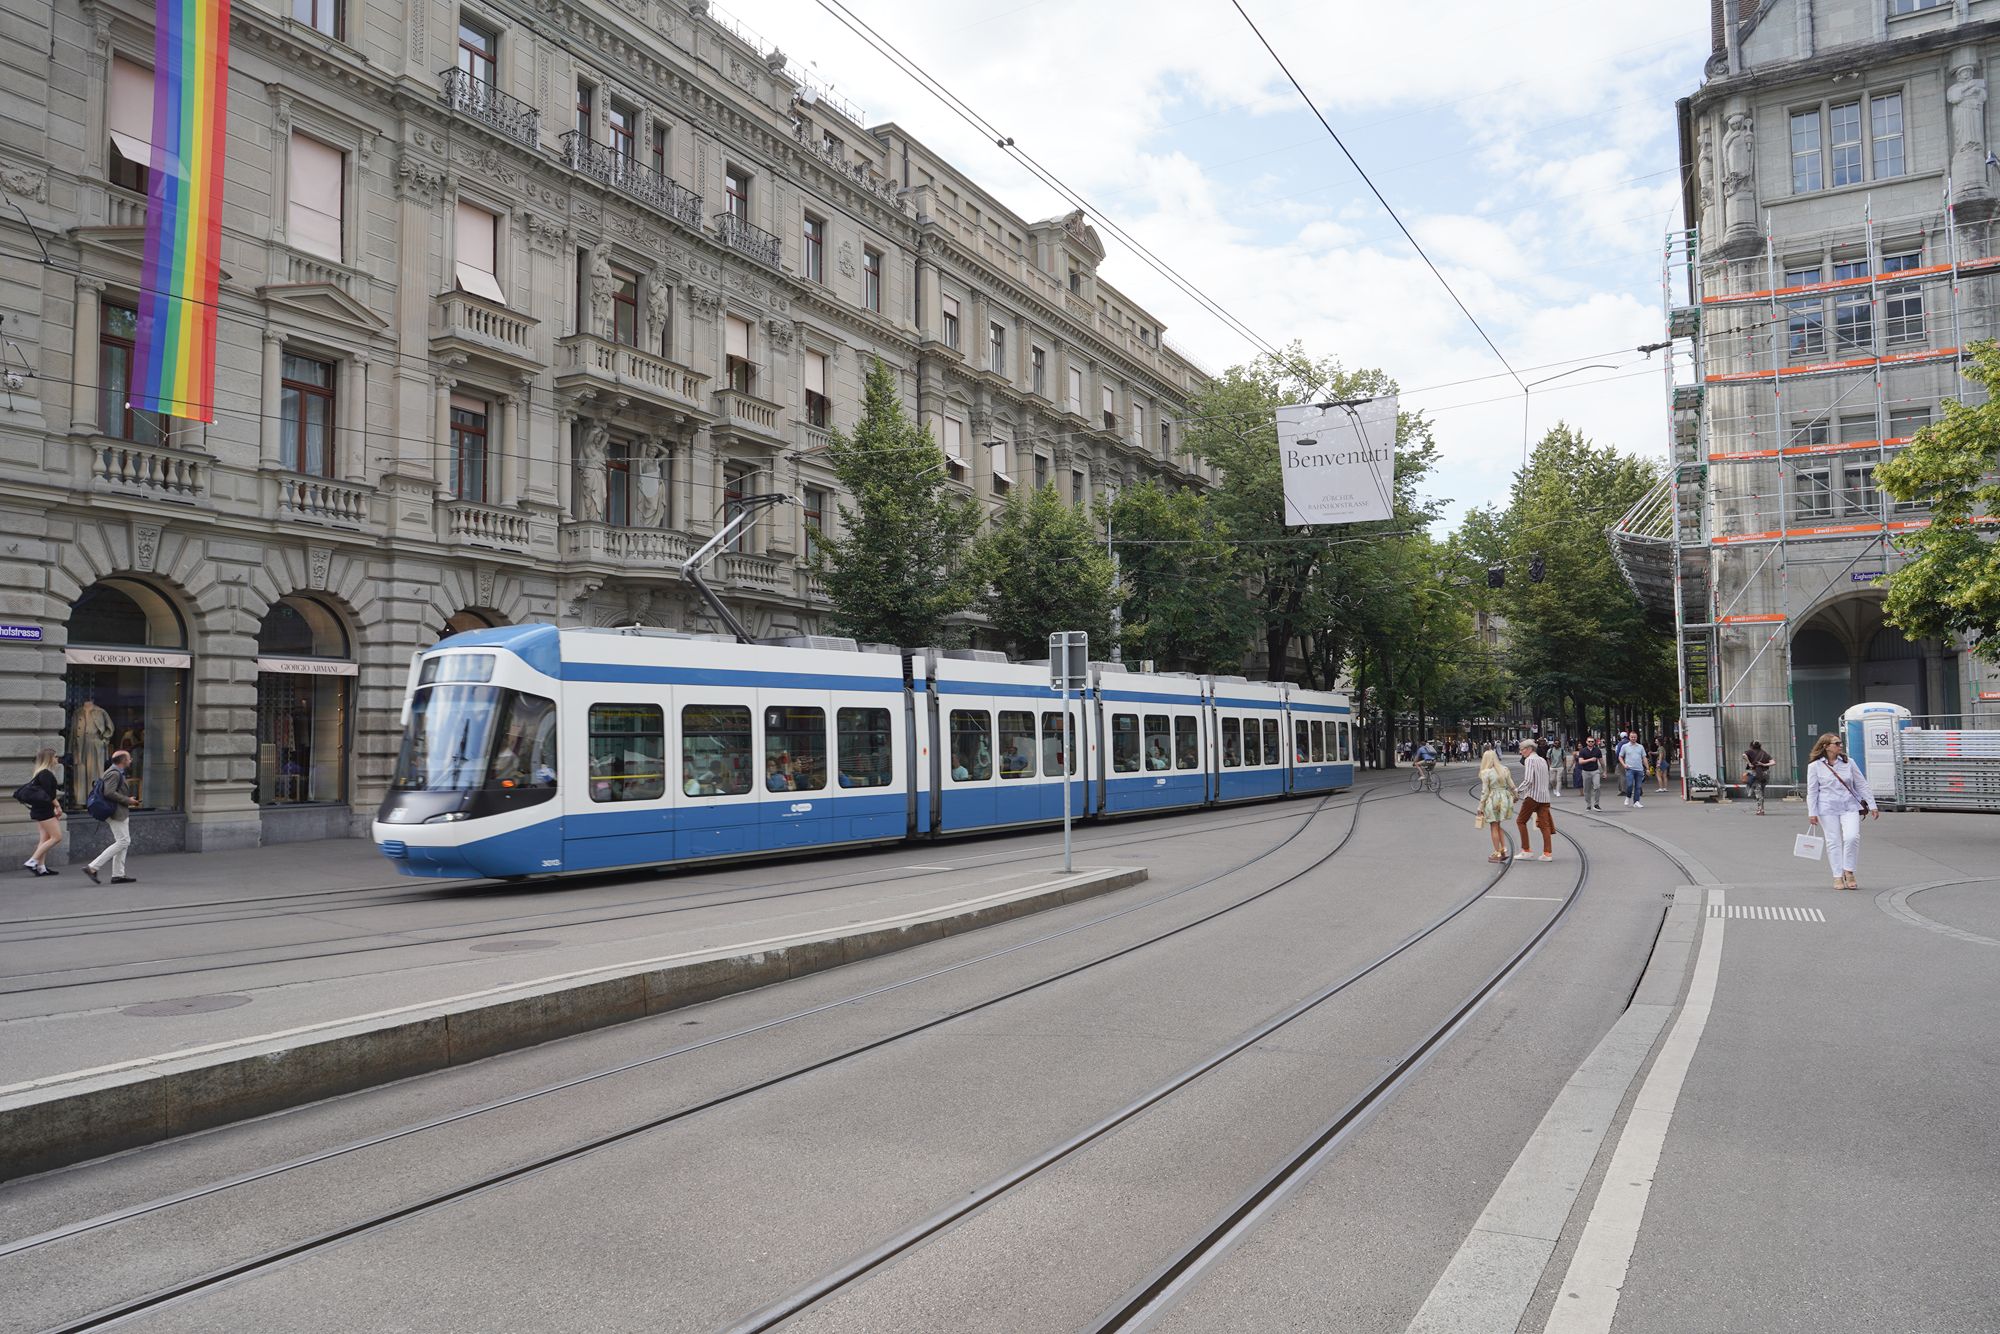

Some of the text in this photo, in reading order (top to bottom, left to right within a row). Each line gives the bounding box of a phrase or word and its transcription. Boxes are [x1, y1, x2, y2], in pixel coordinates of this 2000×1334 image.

[1287, 442, 1389, 469] Benvenuti
[1308, 500, 1369, 511] BAHNHOFSTRASSE
[93, 654, 166, 665] GIORGIO ARMANI
[280, 663, 338, 673] GIORGIO ARMANI
[770, 714, 778, 725] 7
